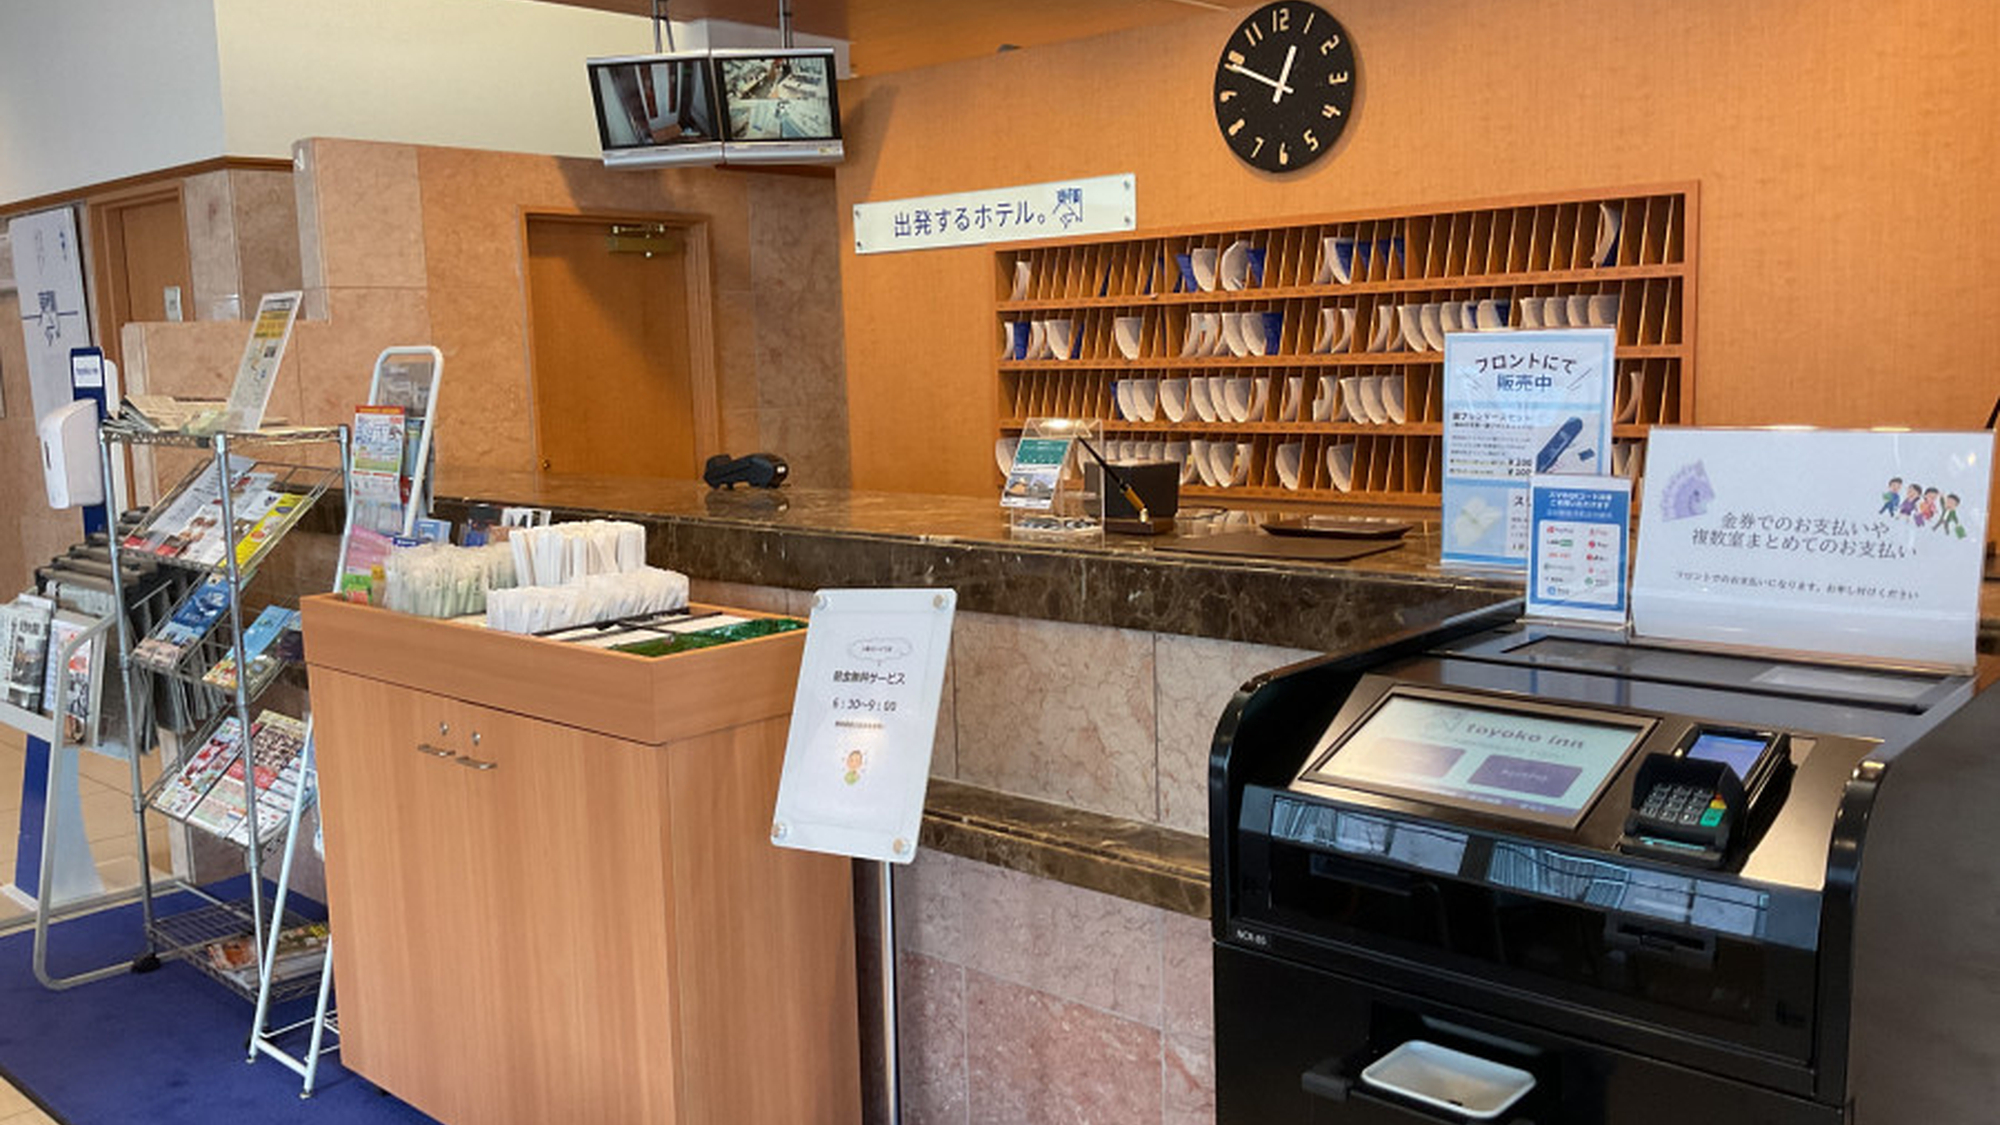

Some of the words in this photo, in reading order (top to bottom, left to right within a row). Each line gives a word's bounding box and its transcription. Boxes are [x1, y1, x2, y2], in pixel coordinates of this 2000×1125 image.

[1272, 8, 1290, 32] 12
[1303, 12, 1315, 35] 1
[1244, 22, 1263, 46] 11
[1320, 34, 1340, 56] 2
[1329, 71, 1348, 85] 3
[1219, 90, 1238, 102] 9
[1322, 104, 1341, 118] 4
[1228, 118, 1245, 136] 8
[1251, 136, 1265, 158] 7
[1303, 129, 1319, 151] 5
[1279, 142, 1288, 164] 6
[894, 200, 1046, 238] 出発するホテル。
[1497, 374, 1552, 392] 販売中
[1721, 512, 1890, 539] 金券でのお支払いや
[1692, 529, 1917, 559] 複数室まとめてのお支払い
[1466, 721, 1541, 744] toyoko
[1547, 732, 1585, 750] inn
